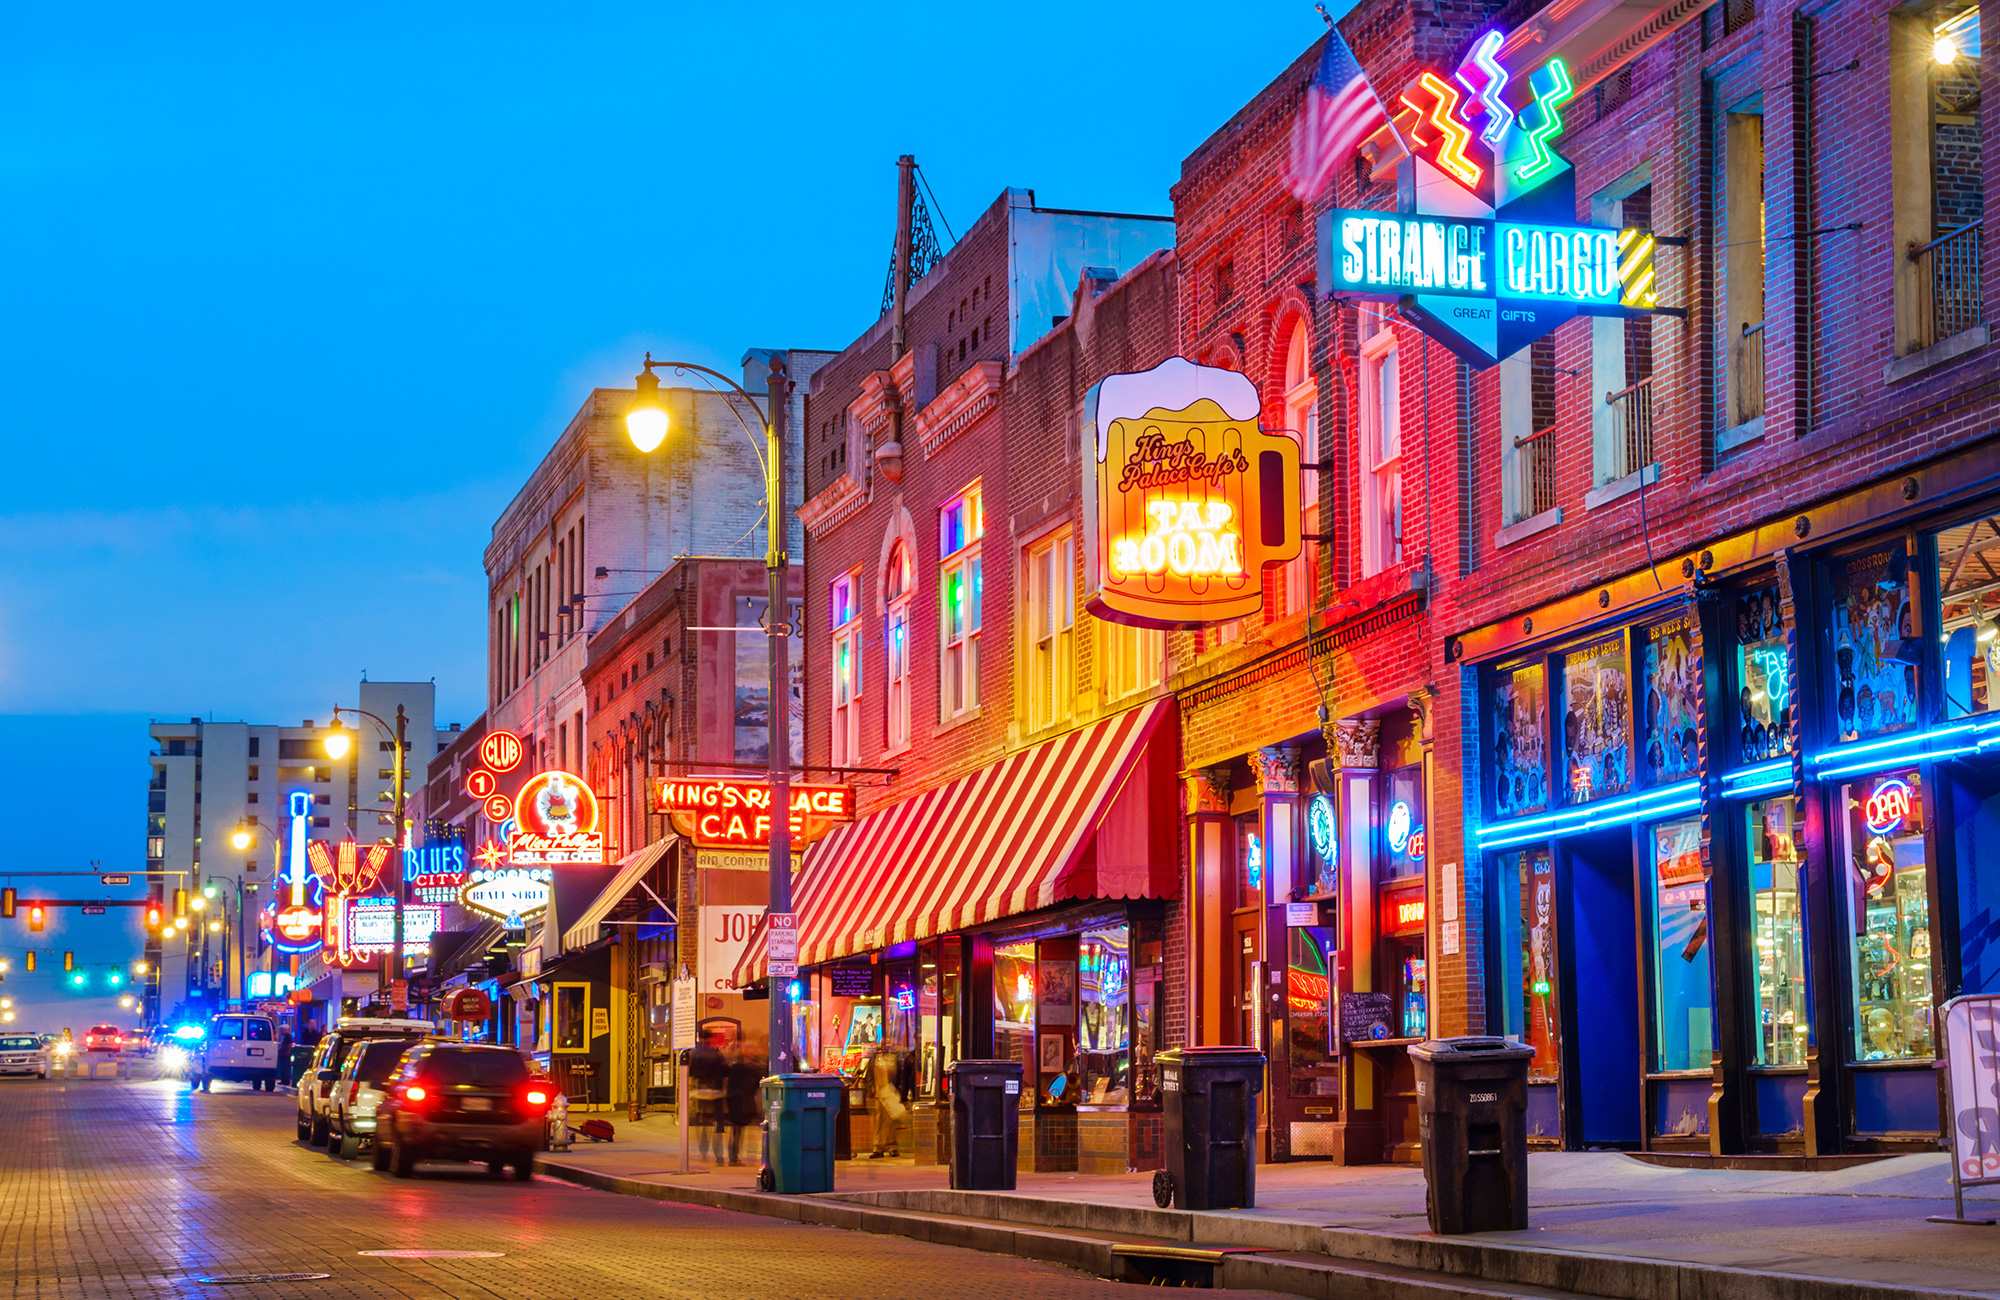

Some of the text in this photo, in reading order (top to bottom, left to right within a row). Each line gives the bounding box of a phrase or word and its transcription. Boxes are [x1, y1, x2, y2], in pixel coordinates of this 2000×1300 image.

[1342, 218, 1613, 299] STRANGE CARGO
[1453, 308, 1536, 322] GREAT GIFTS
[1130, 433, 1195, 468] Kings
[1118, 448, 1249, 493] Palace Cafe's
[1149, 501, 1233, 535] TAP
[1115, 532, 1243, 574] ROOM
[486, 735, 518, 767] CLUB
[475, 776, 486, 793] 1
[663, 782, 844, 814] KING'S PACE
[1866, 790, 1910, 826] OPEN
[492, 800, 506, 817] 5
[701, 814, 803, 840] CAFE
[513, 833, 552, 849] Miss
[1409, 834, 1424, 857] OPE
[407, 846, 464, 883] BLUES
[699, 855, 798, 868] AIR CONDITID
[1534, 861, 1551, 875] Kit-C
[416, 873, 463, 887] CITY
[422, 893, 456, 903] STORE
[511, 890, 544, 900] STREE
[774, 916, 792, 927] NO
[1163, 1081, 1180, 1091] STREET
